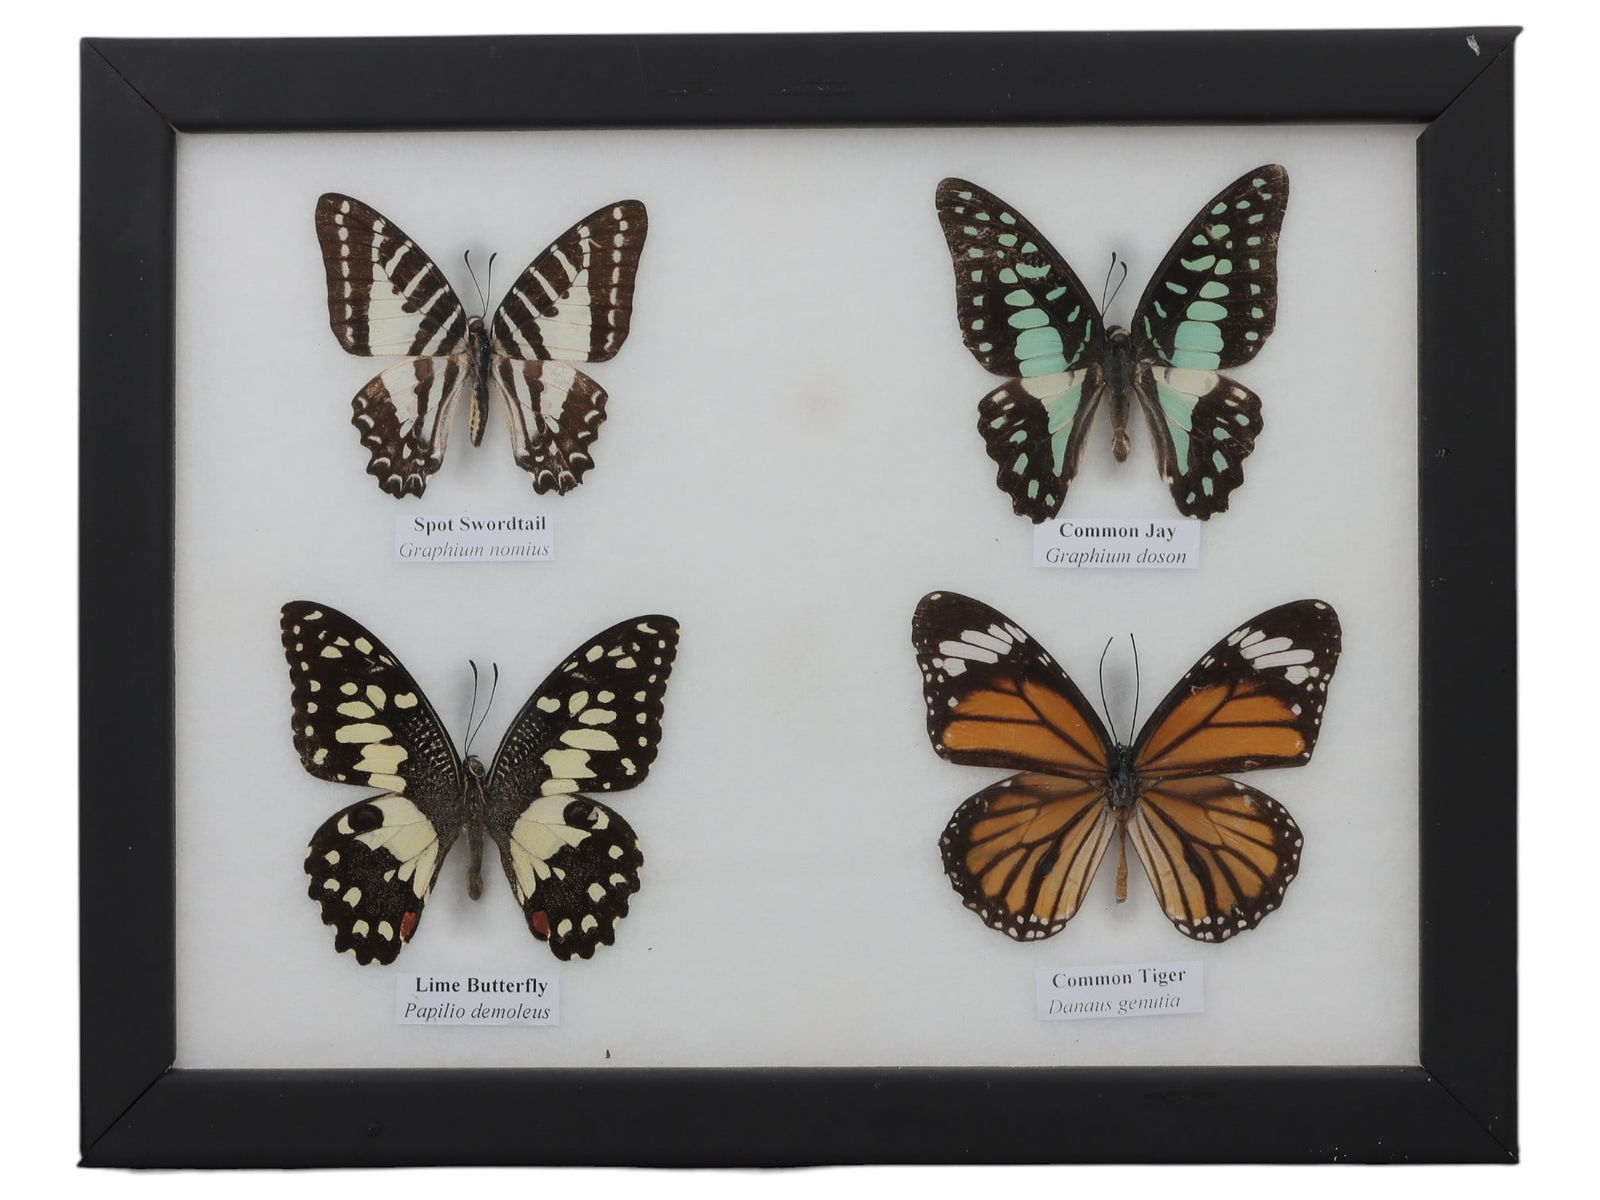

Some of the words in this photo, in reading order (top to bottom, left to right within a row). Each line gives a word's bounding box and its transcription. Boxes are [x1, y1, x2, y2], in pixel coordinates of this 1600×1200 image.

[414, 516, 453, 536] Spot
[459, 516, 546, 531] Swordtail
[1059, 522, 1139, 538] Common
[1145, 523, 1176, 542] Jay
[399, 541, 484, 561] Graphium
[489, 541, 550, 557] nomius
[1046, 547, 1131, 567] Graphium
[1136, 547, 1187, 563] doson
[416, 977, 461, 993] Lime
[467, 977, 548, 997] Butterfly
[1052, 972, 1133, 989] Common
[1138, 968, 1187, 987] Tiger
[404, 1002, 466, 1022] Papilio
[471, 1002, 551, 1020] demoleus
[1049, 999, 1113, 1015] Danaus
